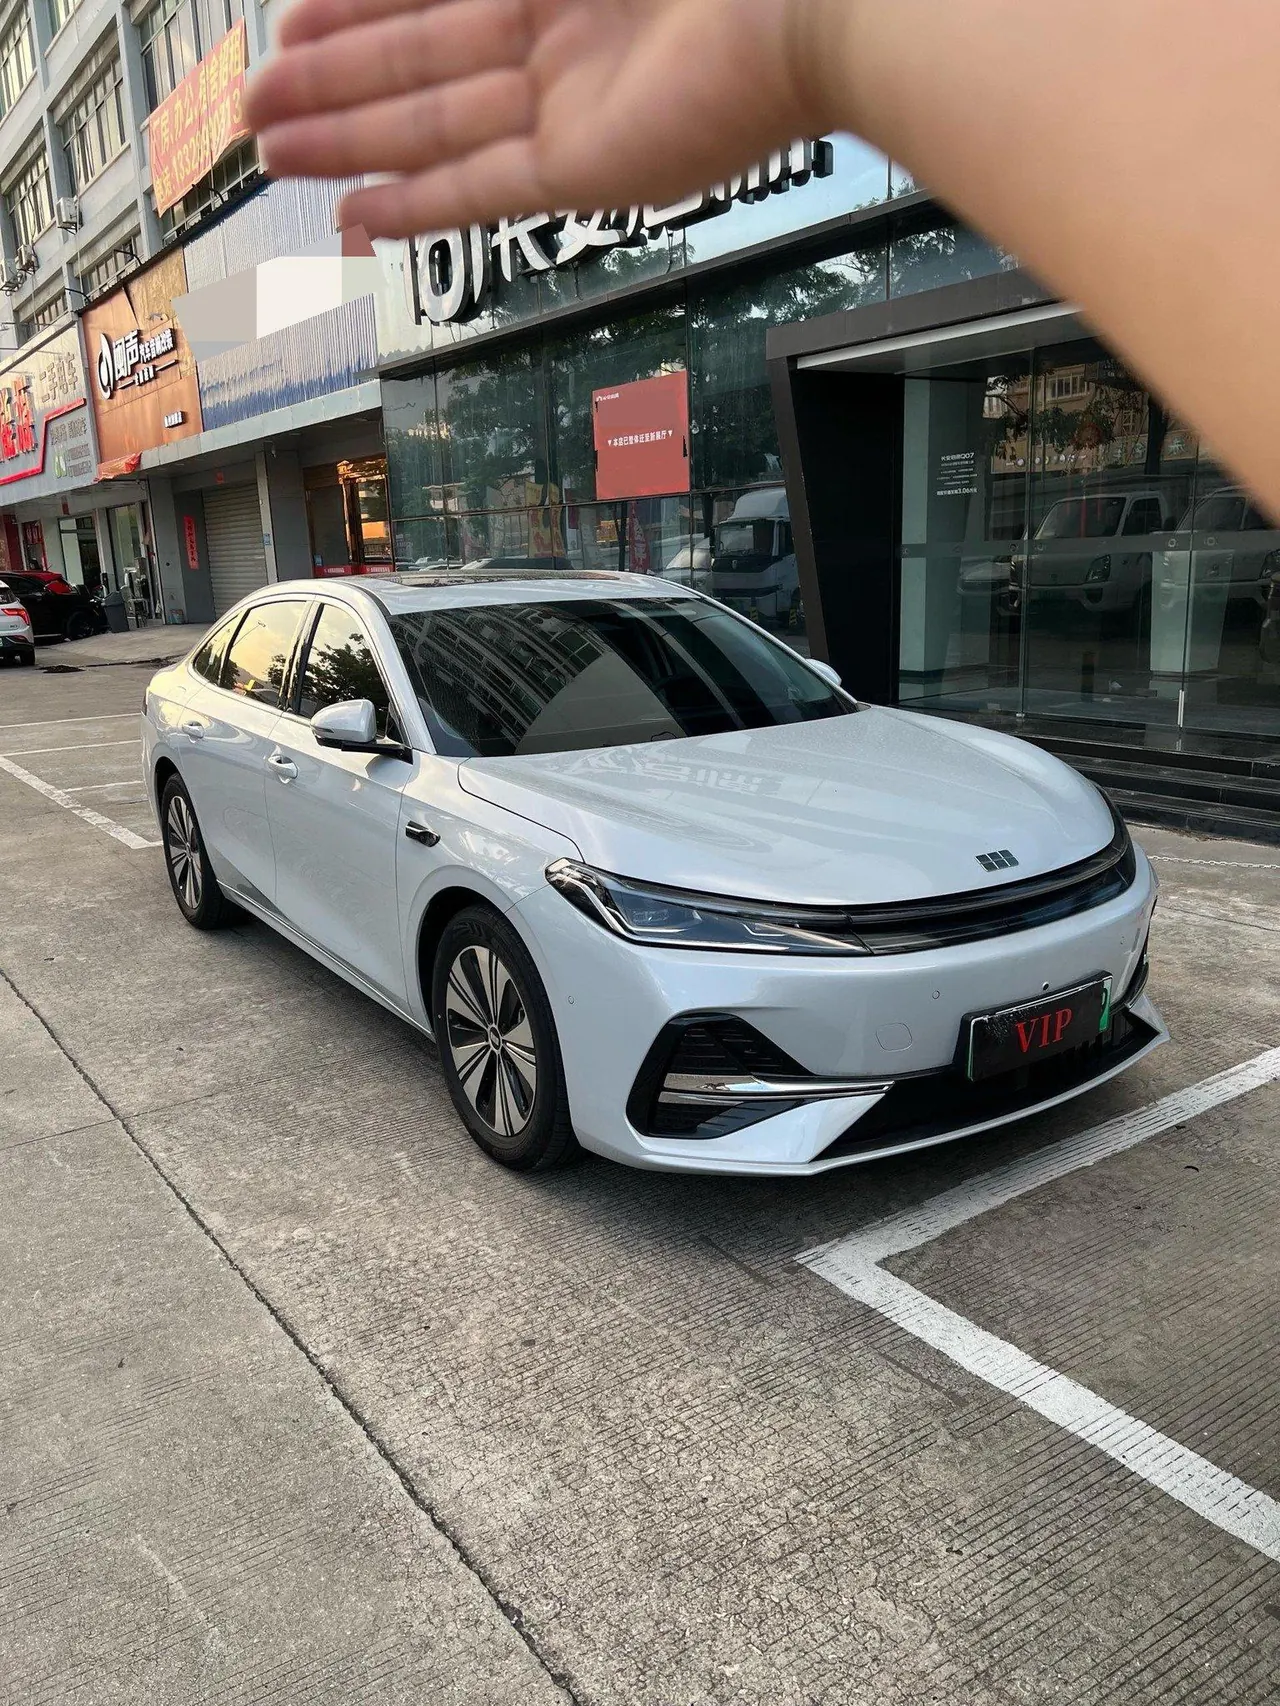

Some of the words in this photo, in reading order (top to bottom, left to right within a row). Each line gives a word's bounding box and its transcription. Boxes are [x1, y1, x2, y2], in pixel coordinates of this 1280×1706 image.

[613, 430, 667, 446] 本店已整体迁至新展厅
[1015, 1008, 1073, 1053] VIP
